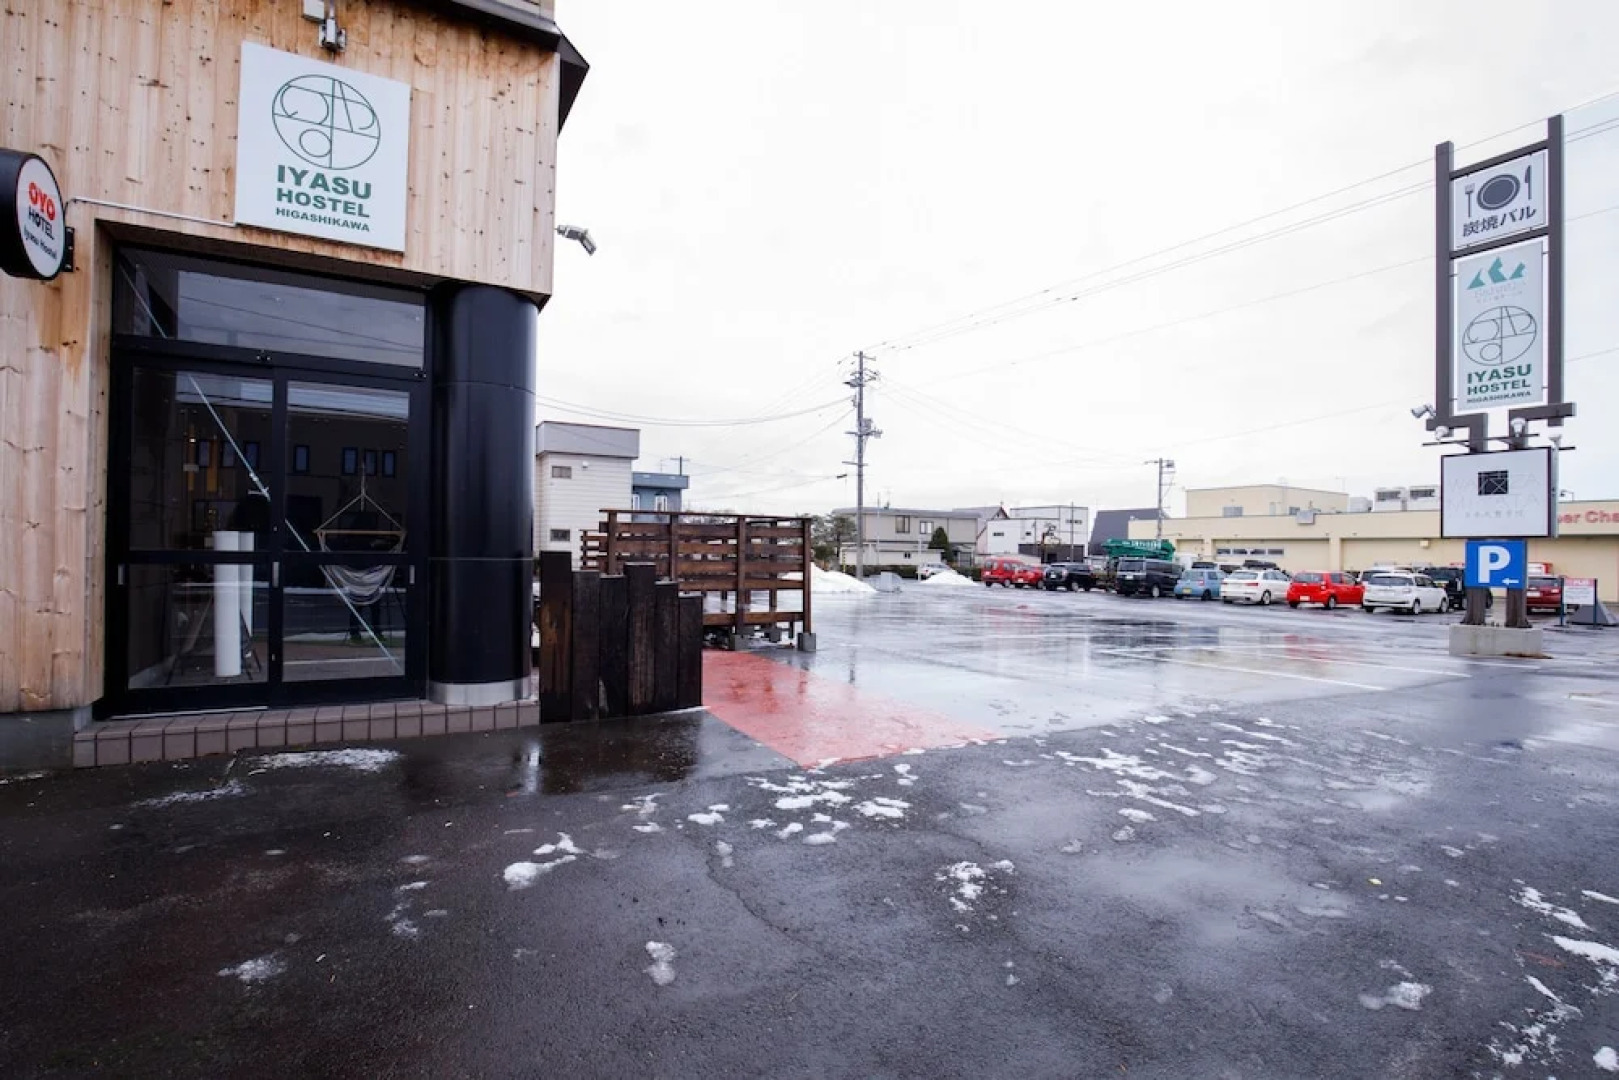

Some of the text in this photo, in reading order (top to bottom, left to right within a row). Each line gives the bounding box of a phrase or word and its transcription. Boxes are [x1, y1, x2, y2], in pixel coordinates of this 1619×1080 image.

[277, 164, 372, 200] IYASU
[28, 181, 56, 221] OYO
[276, 187, 371, 218] HOSTEL
[28, 203, 55, 240] HOTEL
[275, 207, 371, 232] HIGASHIKAWA
[1462, 205, 1537, 237] 炭焼バル
[1467, 363, 1532, 384] IYASU
[1467, 379, 1531, 395] HOSTEL
[1477, 545, 1511, 584] P
